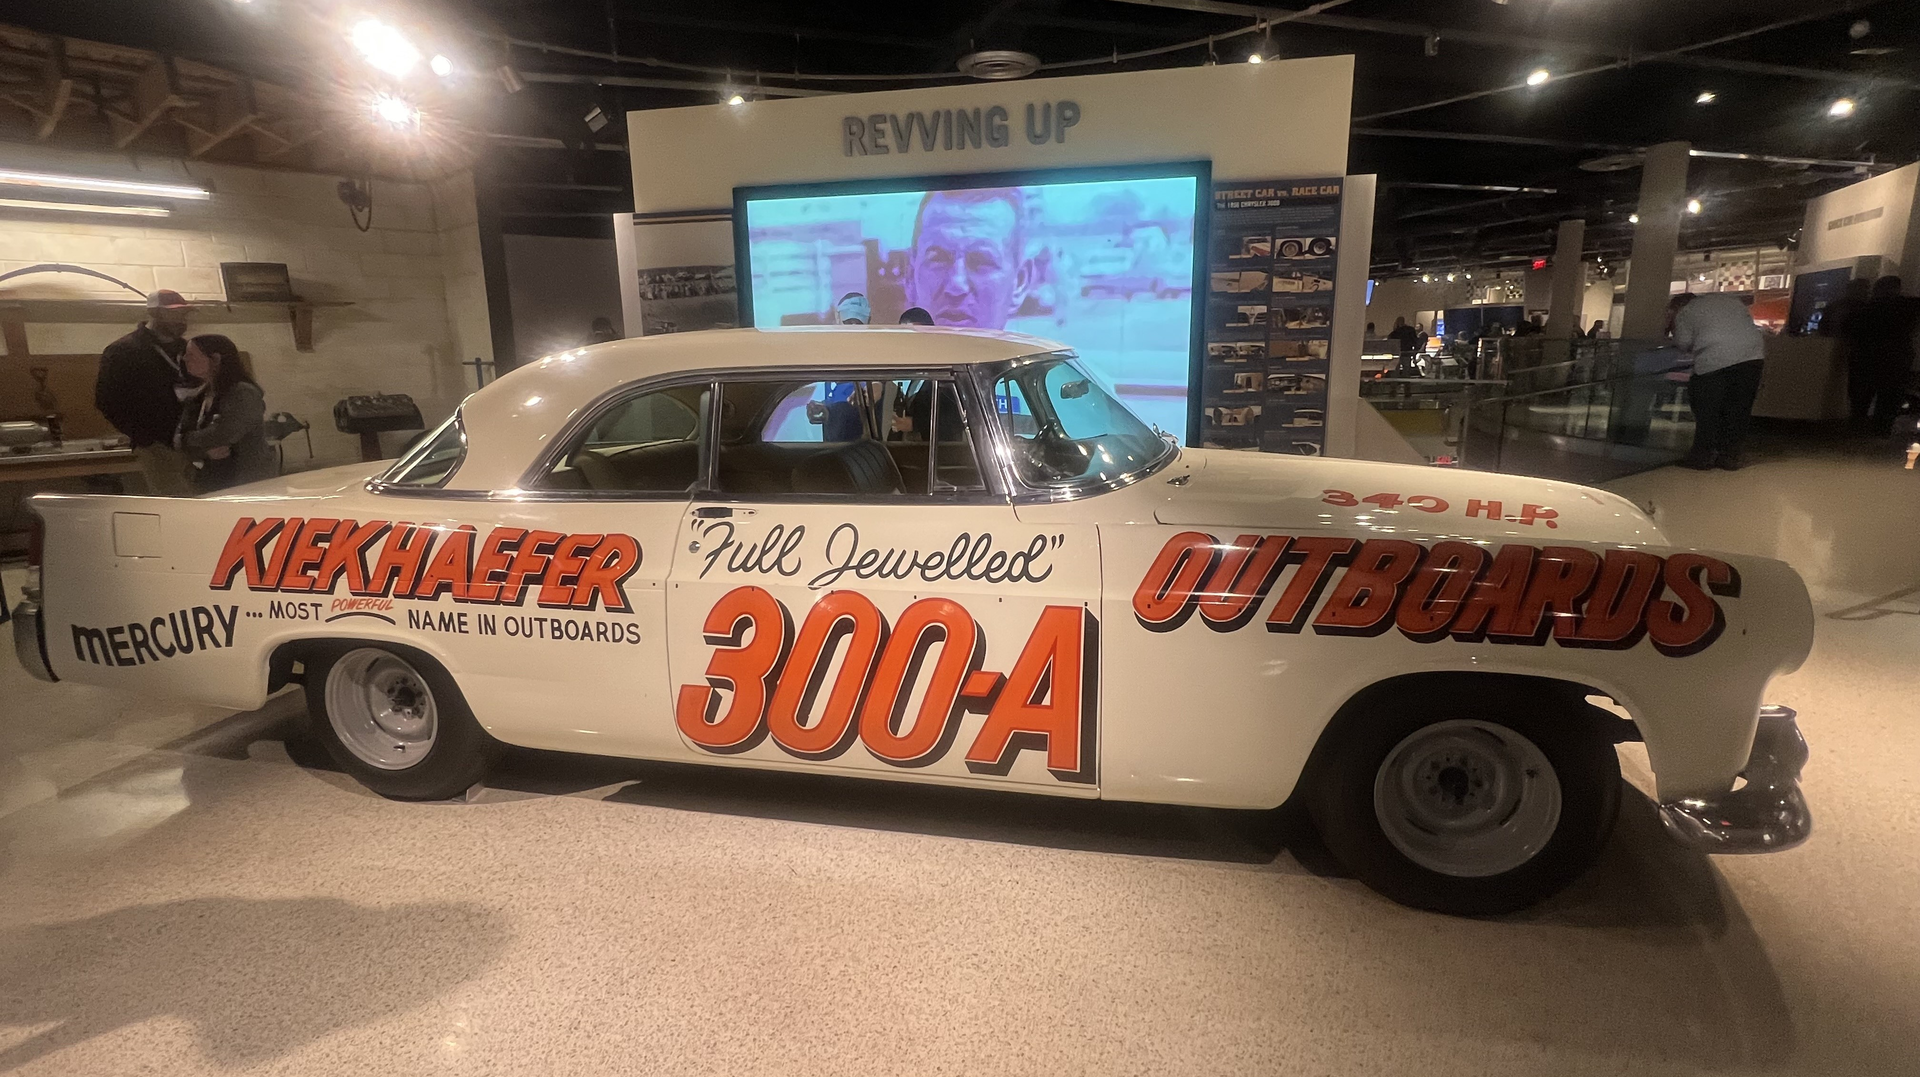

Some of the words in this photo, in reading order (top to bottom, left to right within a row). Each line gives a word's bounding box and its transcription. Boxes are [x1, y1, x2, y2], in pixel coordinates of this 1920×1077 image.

[843, 105, 1009, 157] REVVING
[1026, 99, 1081, 145] UP
[1214, 189, 1253, 200] STREET
[1255, 188, 1275, 198] CAR
[1291, 186, 1318, 196] RACE
[1320, 185, 1340, 195] CAR
[1322, 489, 1449, 513] 340
[1465, 499, 1559, 529] H.P.
[209, 516, 644, 615] KIEKHAEFER
[1132, 530, 1742, 658] OUTBOARDS
[269, 600, 323, 621] MOST
[330, 598, 394, 613] POWERFUL
[408, 609, 468, 634] NAME
[478, 614, 497, 636] IN
[504, 616, 641, 645] OUTBOARDS
[676, 585, 1099, 785] 300-A
